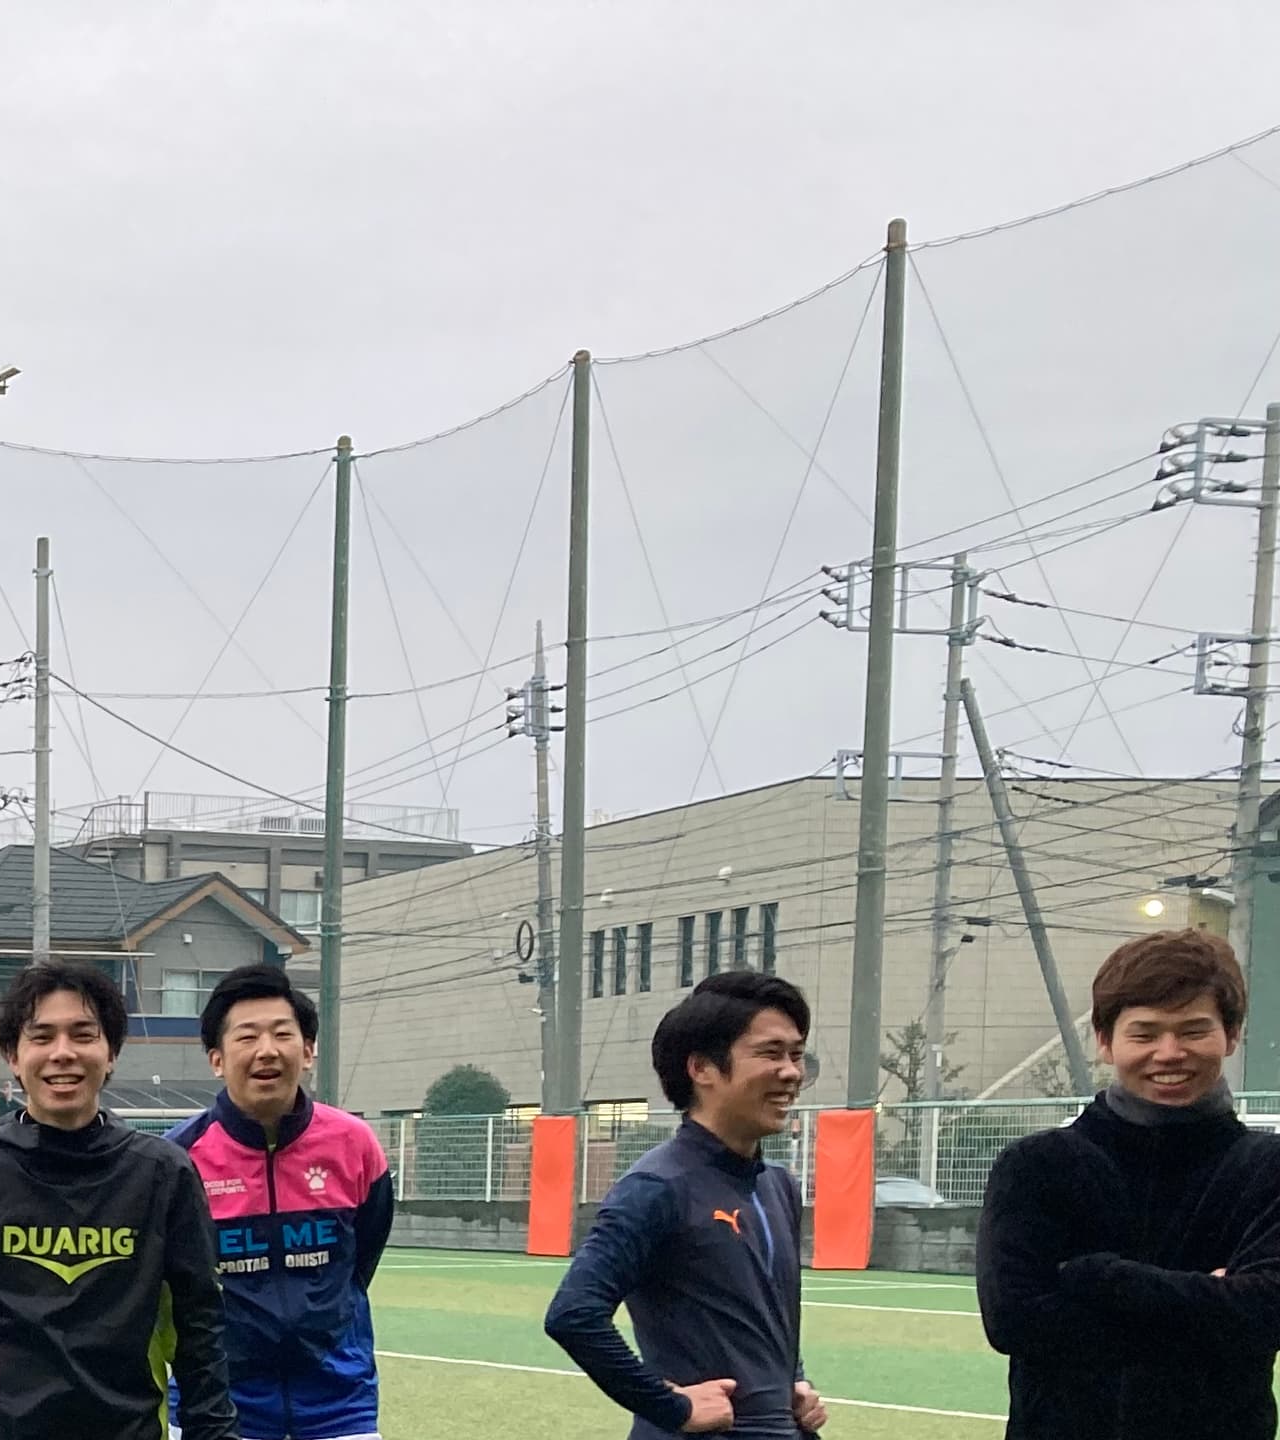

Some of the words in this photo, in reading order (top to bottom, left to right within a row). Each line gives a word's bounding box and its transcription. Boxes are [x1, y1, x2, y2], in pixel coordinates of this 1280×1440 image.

[2, 1225, 135, 1256] DUARIG
[219, 1228, 269, 1254] EL
[282, 1219, 338, 1248] ME
